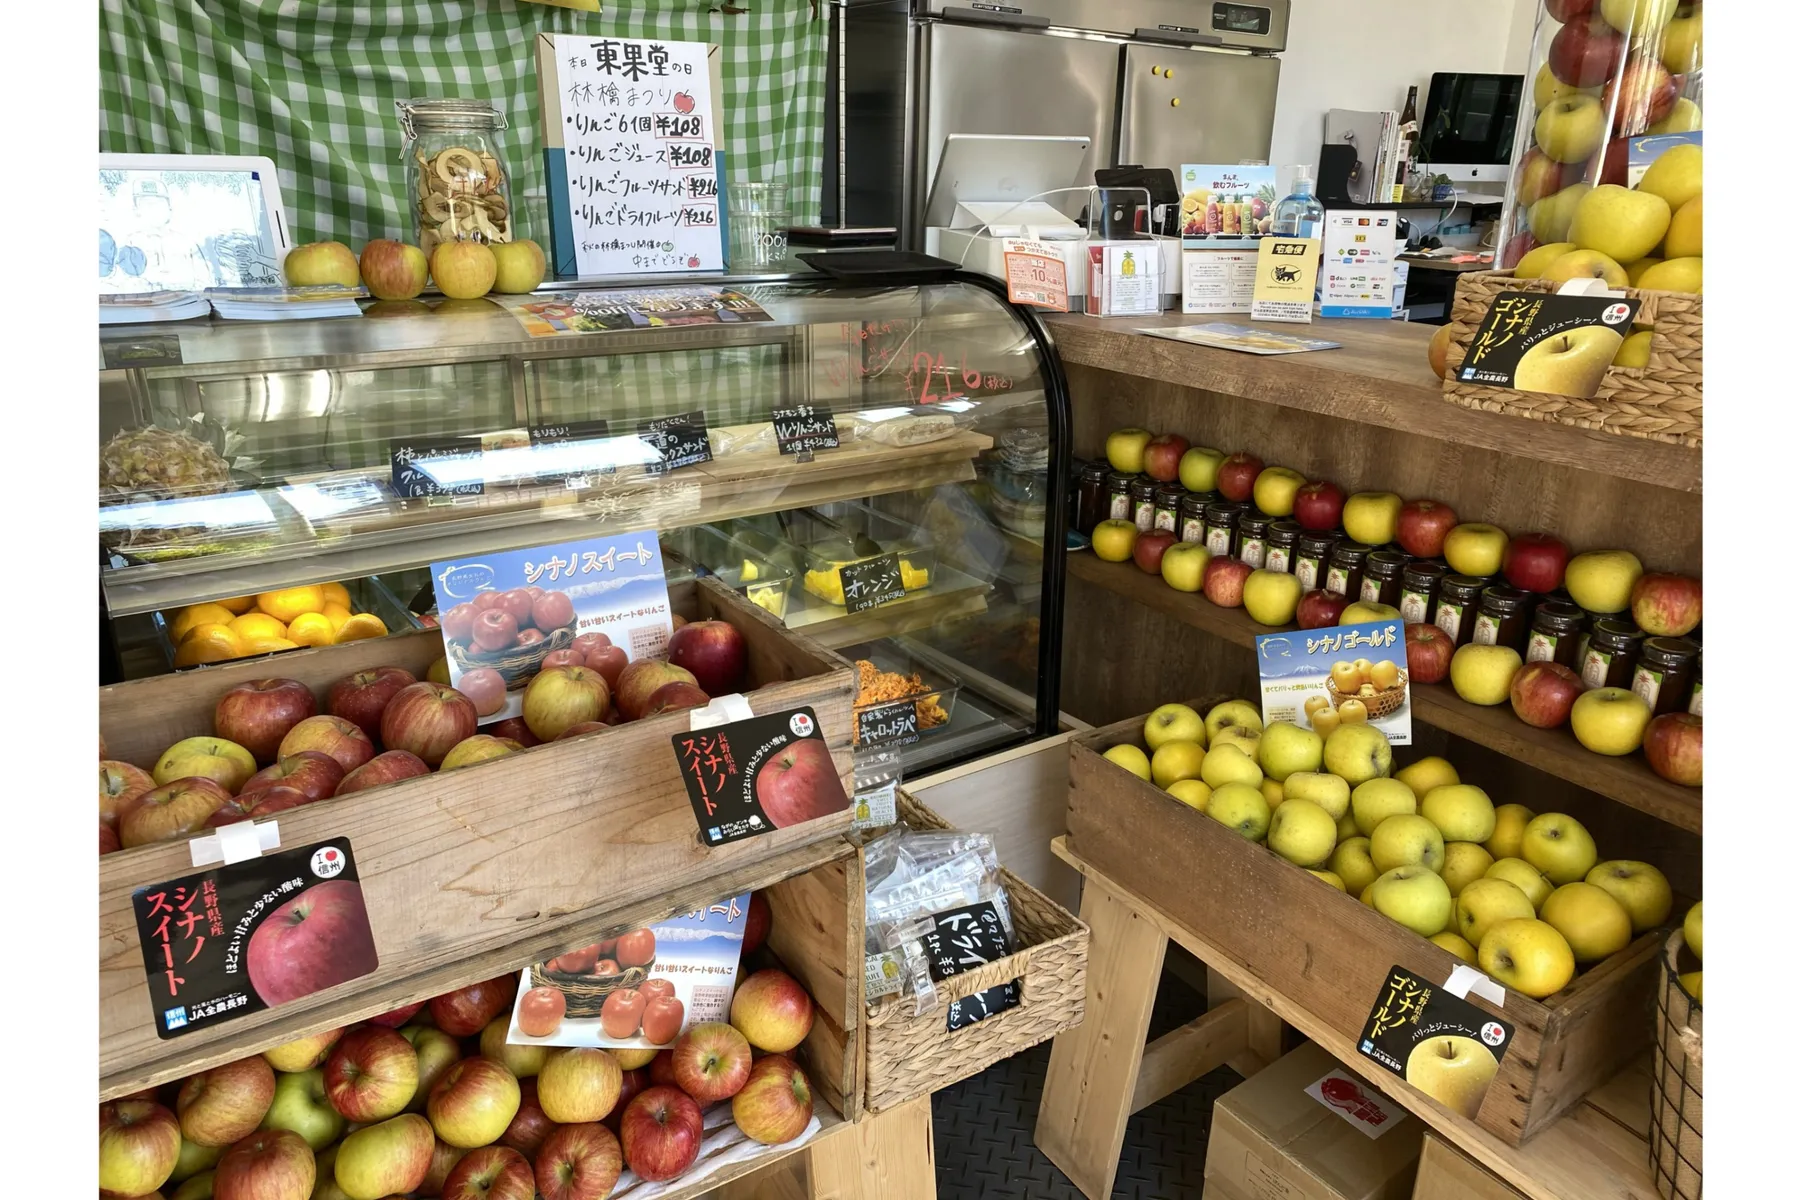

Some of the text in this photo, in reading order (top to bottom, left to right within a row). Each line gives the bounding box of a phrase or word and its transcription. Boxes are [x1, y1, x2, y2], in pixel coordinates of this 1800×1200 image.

[568, 81, 672, 107] 林檎まつり
[655, 115, 701, 137] ¥108
[670, 145, 712, 167] ¥108
[688, 177, 718, 197] ¥216
[684, 208, 714, 225] ¥216
[1275, 244, 1305, 255] 宅急便
[1472, 296, 1519, 365] ゴールド
[1493, 297, 1534, 348] シナノ
[1517, 299, 1545, 336] 長野県産
[775, 417, 835, 440] Wりんごサンド
[522, 540, 654, 584] シナノスイート
[844, 568, 900, 599] オレンジ
[578, 603, 667, 629] 甘い甘いスイートなりんご
[1305, 625, 1398, 655] シナノゴールド
[860, 714, 917, 745] キャロットラペ
[699, 735, 727, 794] シナノ
[717, 731, 739, 775] 長野県産
[743, 734, 788, 804] ほどよい甘みと少ない酸味
[681, 738, 718, 817] スイート
[317, 860, 341, 876] 信州
[173, 886, 206, 965] シナノ
[201, 879, 225, 938] 長野県産
[225, 876, 305, 974] ほどよい甘みと少ない酸味
[146, 891, 186, 997] スイート
[654, 963, 734, 976] 甘い甘いスイートなりんご
[188, 996, 249, 1021] JA全農長野
[1371, 974, 1411, 1039] ゴールド
[1388, 980, 1423, 1029] シナノ
[1409, 988, 1432, 1025] 長野県産
